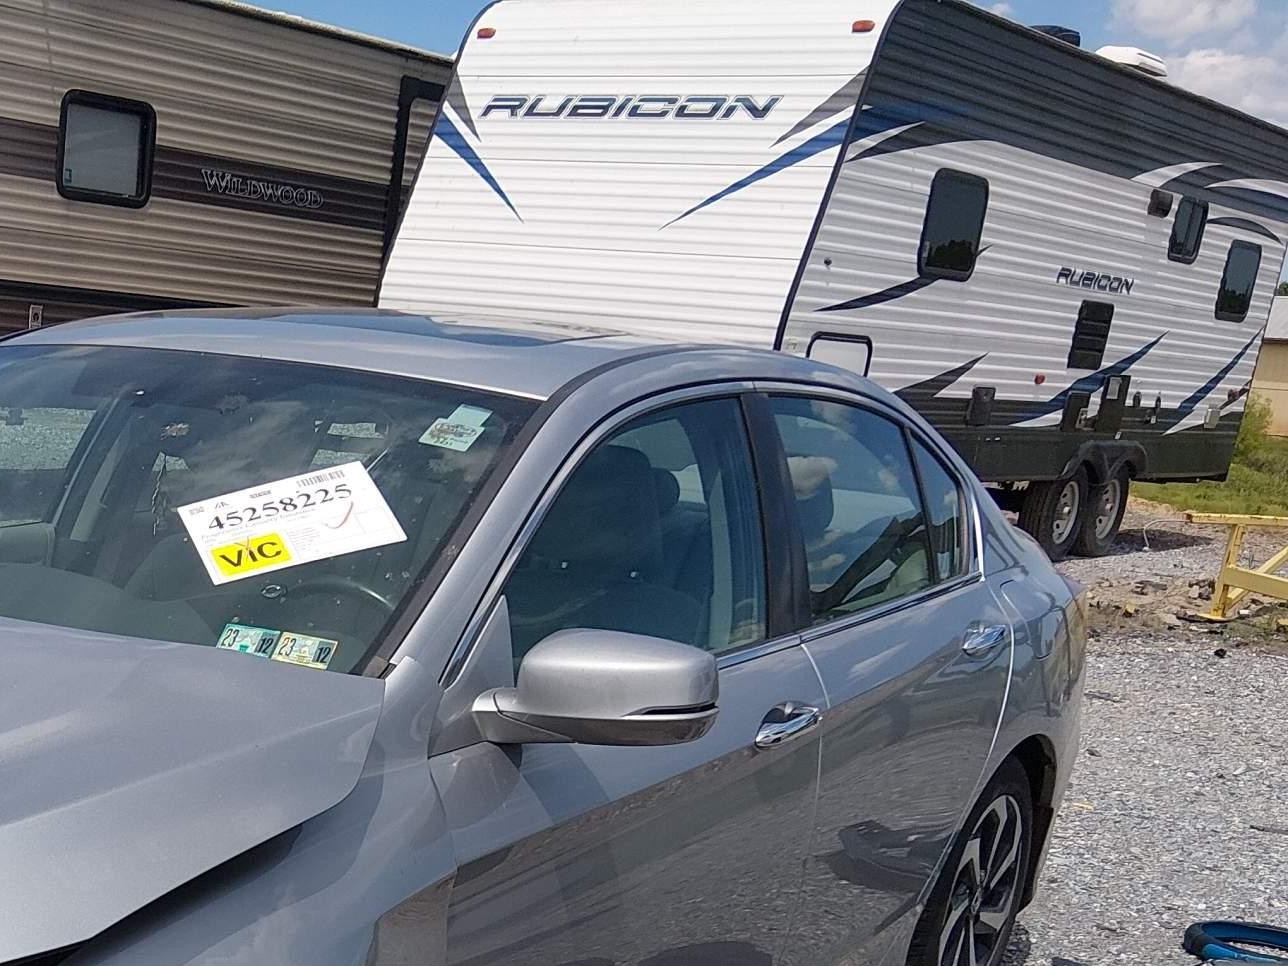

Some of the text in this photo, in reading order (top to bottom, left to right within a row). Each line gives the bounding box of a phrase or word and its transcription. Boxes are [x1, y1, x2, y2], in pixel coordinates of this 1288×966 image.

[477, 94, 784, 121] RUBICON
[201, 168, 324, 209] WILDWOOD
[1056, 266, 1135, 295] RUBICON
[209, 483, 352, 530] 45258225
[219, 541, 282, 568] VIC
[220, 628, 274, 655] 23 12
[278, 637, 331, 664] 23 12
